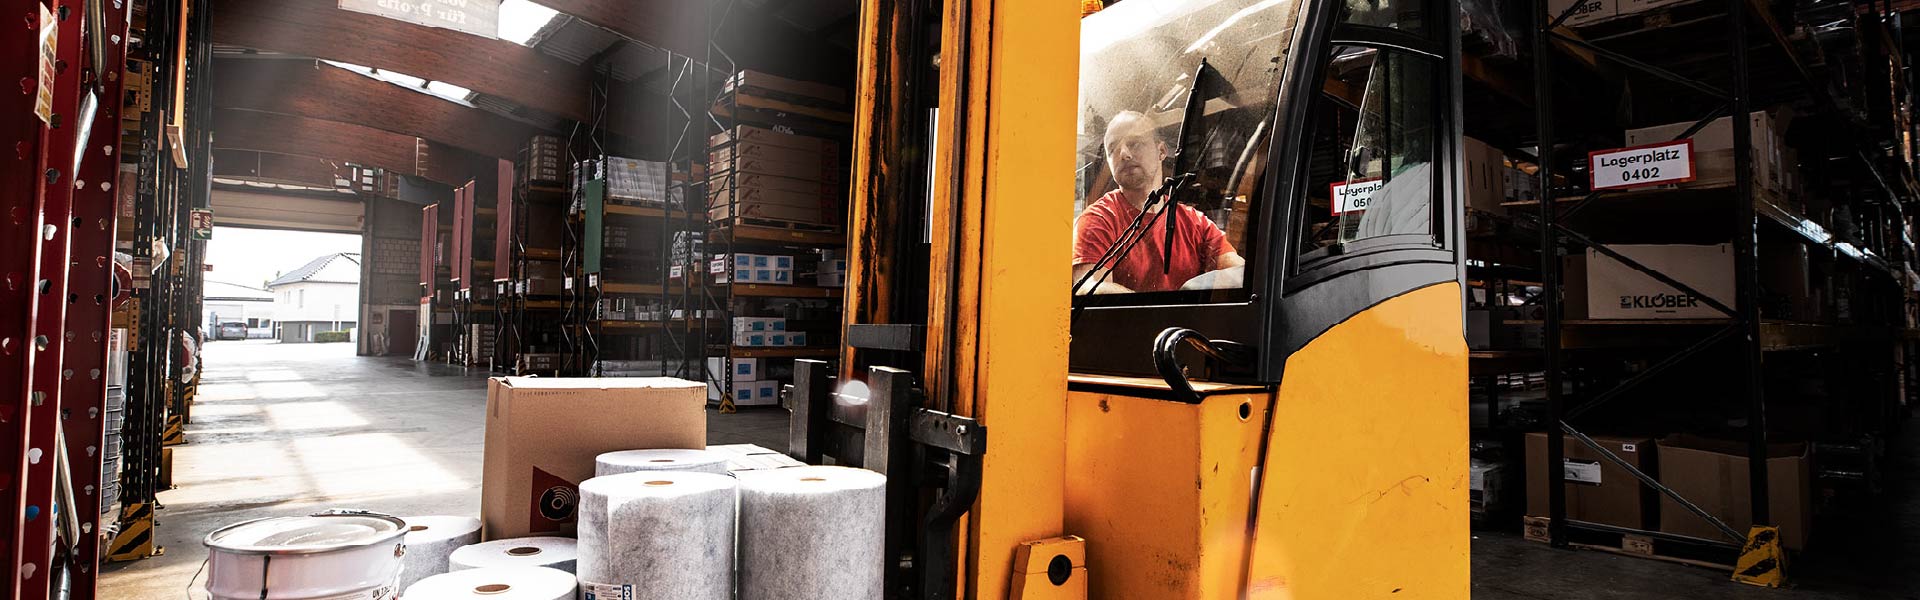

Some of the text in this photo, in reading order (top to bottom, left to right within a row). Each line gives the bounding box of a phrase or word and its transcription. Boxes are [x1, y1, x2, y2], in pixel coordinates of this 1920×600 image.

[1601, 149, 1680, 168] Lagerplatz
[1622, 167, 1660, 182] 0402
[1339, 183, 1382, 196] Lagerpla
[1353, 198, 1372, 207] 050
